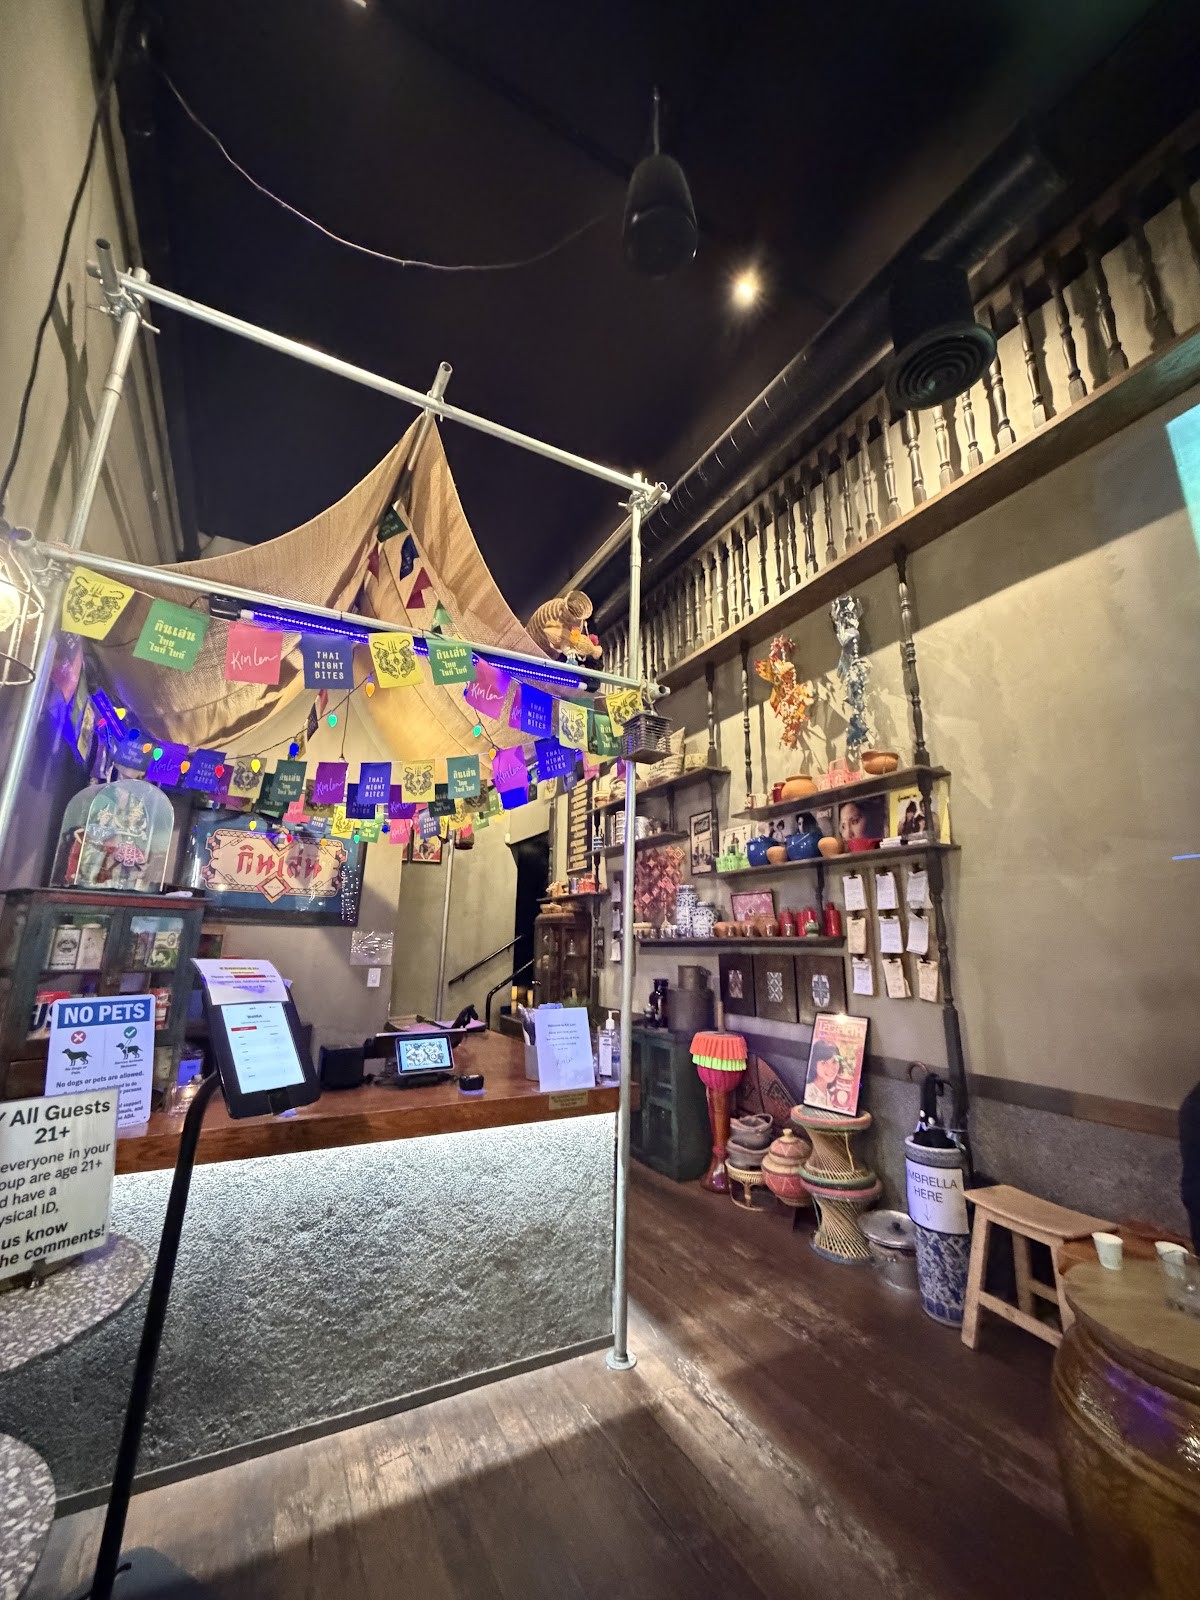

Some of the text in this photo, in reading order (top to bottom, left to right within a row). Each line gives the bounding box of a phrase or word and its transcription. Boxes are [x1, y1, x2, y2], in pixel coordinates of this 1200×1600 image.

[317, 651, 339, 660] THAI
[314, 661, 344, 670] NIGHT
[314, 671, 345, 680] BITES
[236, 845, 323, 879] กินเล่น
[63, 1005, 94, 1025] NO
[99, 1003, 146, 1022] PETS
[67, 1078, 83, 1087] dogs
[93, 1075, 107, 1084] pets
[108, 1073, 118, 1081] are
[119, 1070, 144, 1079] allowed.
[9, 1107, 39, 1128] All
[45, 1100, 111, 1121] Guests
[34, 1126, 70, 1144] 21+
[0, 1143, 111, 1174] everyone in your
[30, 1172, 51, 1184] are
[55, 1165, 78, 1179] age
[81, 1159, 103, 1173] 21+
[12, 1189, 46, 1206] have
[49, 1187, 57, 1196] a
[914, 1185, 943, 1203] HERE
[41, 1201, 59, 1215] ID,
[1, 1222, 69, 1250] us know
[24, 1223, 105, 1260] comments!
